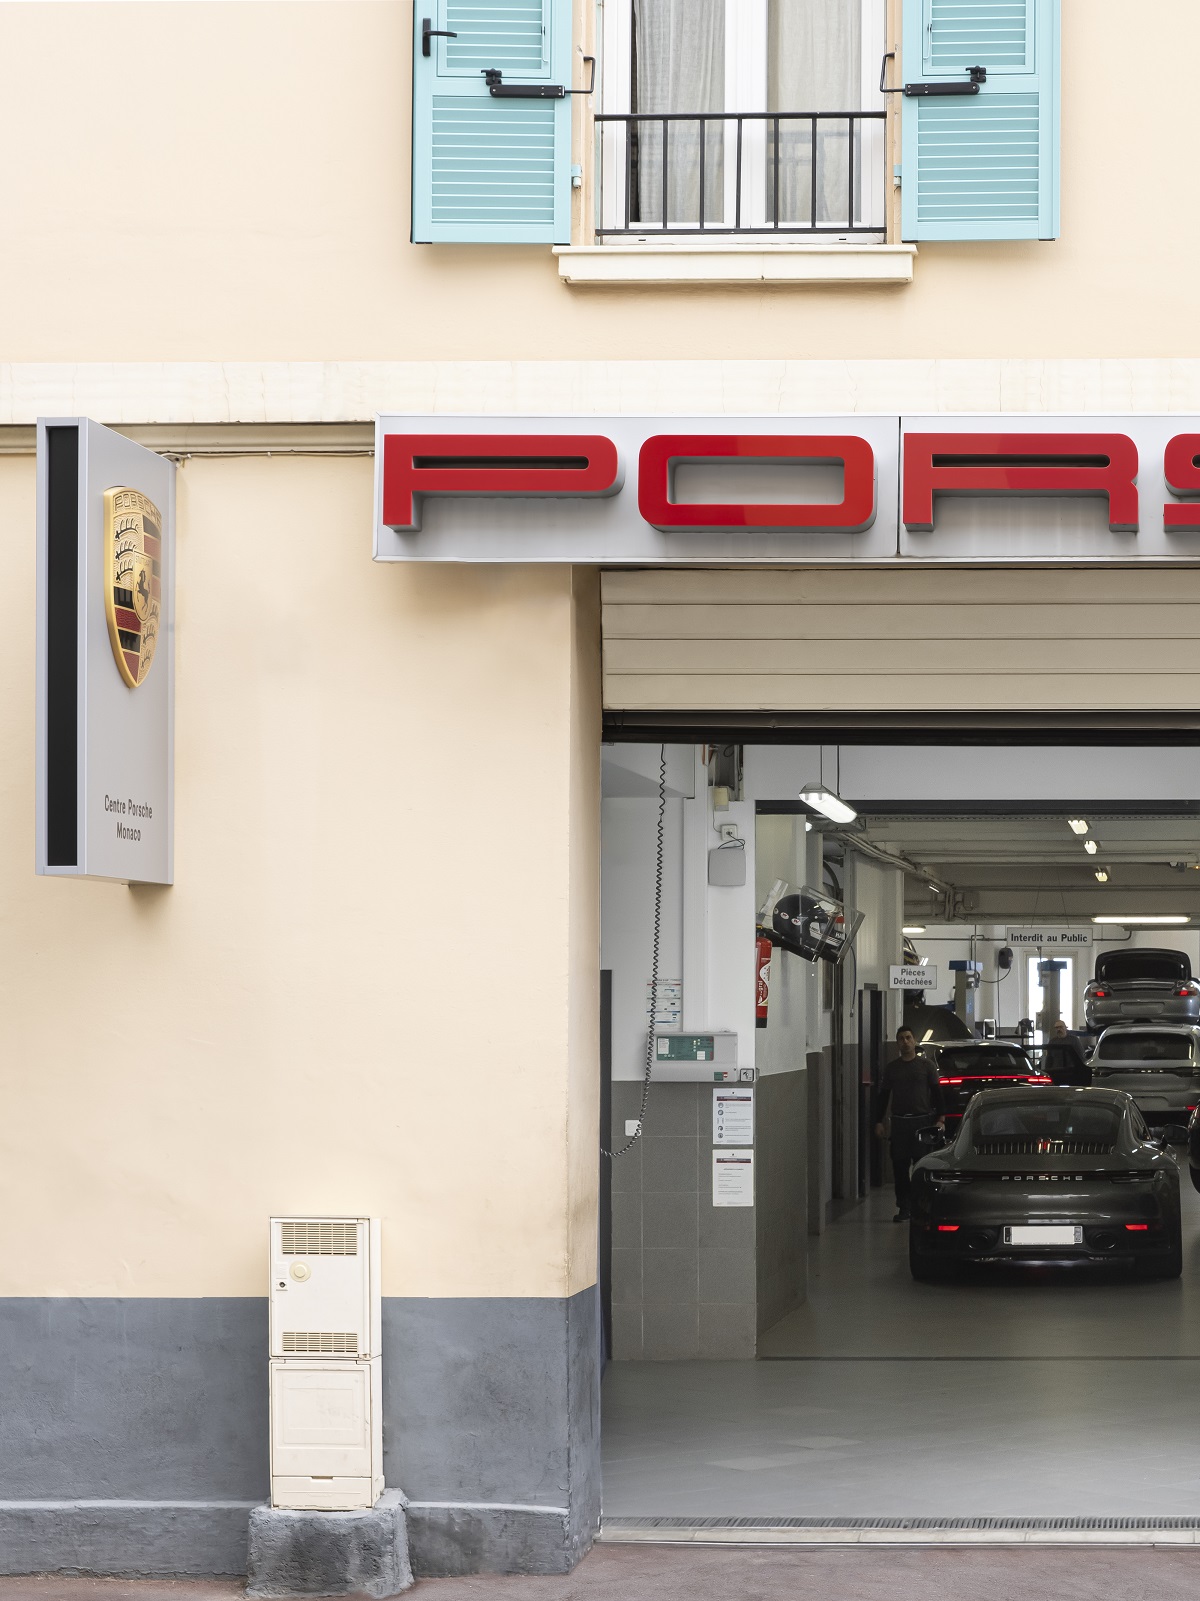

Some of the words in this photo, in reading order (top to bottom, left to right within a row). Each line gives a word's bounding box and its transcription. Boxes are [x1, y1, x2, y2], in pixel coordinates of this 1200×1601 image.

[105, 794, 126, 815] Centre
[128, 799, 153, 819] Porsche
[116, 821, 141, 842] Monaco
[1010, 933, 1044, 943] Interdit
[1046, 935, 1058, 943] au
[1060, 933, 1088, 943] Public
[900, 967, 926, 977] Pièces
[893, 977, 933, 986] Détachées
